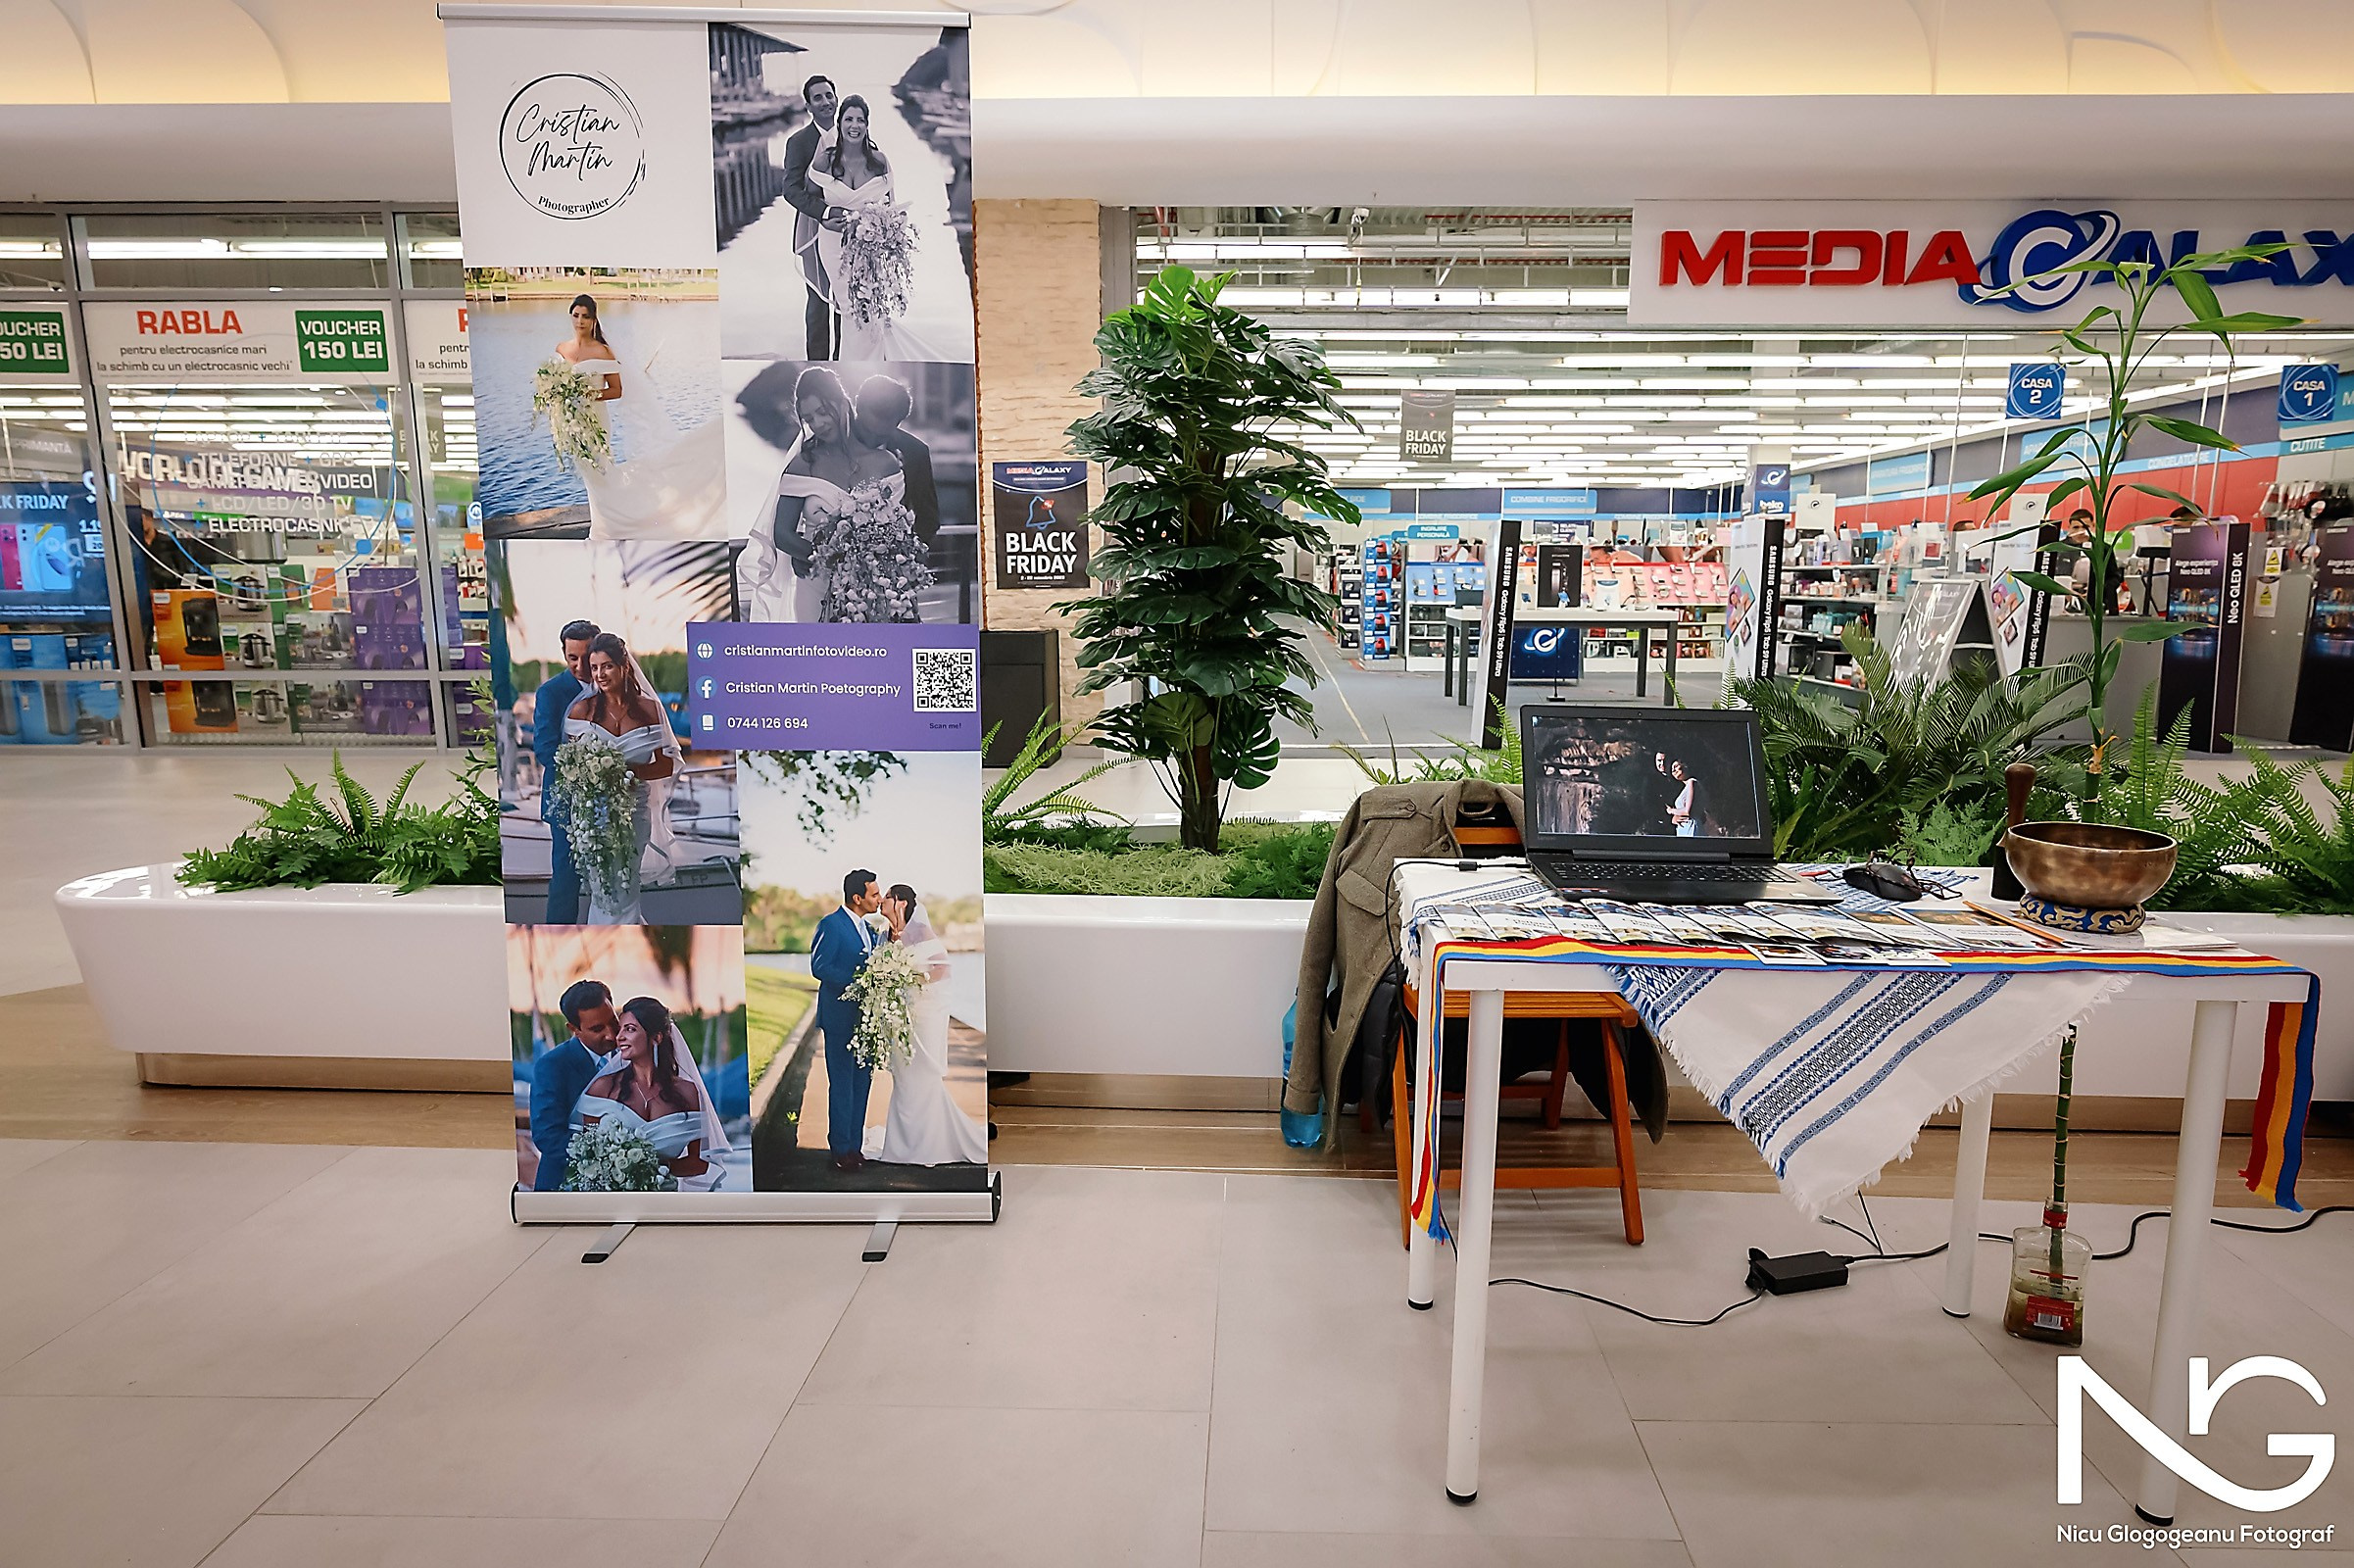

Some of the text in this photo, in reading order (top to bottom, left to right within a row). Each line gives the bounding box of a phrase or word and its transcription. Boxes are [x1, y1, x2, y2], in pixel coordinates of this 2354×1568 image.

[515, 103, 620, 144] Cristian
[527, 140, 613, 181] Martin
[538, 195, 610, 215] Photographer
[1658, 229, 1982, 288] MEDIA
[136, 310, 243, 335] RABLA
[300, 319, 381, 335] VOUCHER
[0, 341, 64, 360] 50 LEI
[120, 345, 267, 356] pentru electrocasnice mari
[303, 341, 383, 359] 150 LEI
[439, 344, 469, 355] pentr
[96, 362, 107, 371] la
[110, 362, 149, 371] schimb
[168, 363, 182, 371] un
[185, 361, 258, 371] electrocasnic
[416, 360, 467, 369] la schimb
[2021, 378, 2053, 389] CASA
[2293, 380, 2326, 391] CASA
[2030, 389, 2042, 404] 2
[2303, 392, 2314, 407] 1
[1405, 429, 1447, 443] BLACK
[1405, 442, 1447, 455] FRIDAY
[197, 452, 354, 466] TELEFOANE GPS
[16, 494, 70, 510] FRIDAY
[329, 496, 352, 511] TV
[1005, 531, 1077, 553] BLACK
[1006, 554, 1078, 574] FRIDAY
[1502, 546, 1514, 587] SAMSUNG
[1767, 545, 1778, 586] SAMSUNG
[2227, 552, 2243, 624] Neo QLED 8K
[1498, 589, 1509, 617] Galaxy
[1764, 588, 1774, 617] Galaxy
[2034, 590, 2045, 620] Galaxy
[724, 644, 887, 658] cristianmartinfotovideo.ro
[1496, 636, 1505, 651] Tab
[2030, 637, 2039, 652] Tab
[1495, 660, 1503, 677] Ultra
[726, 682, 901, 698] Cristian Martin Poetography
[727, 717, 808, 729] 0744 126 694
